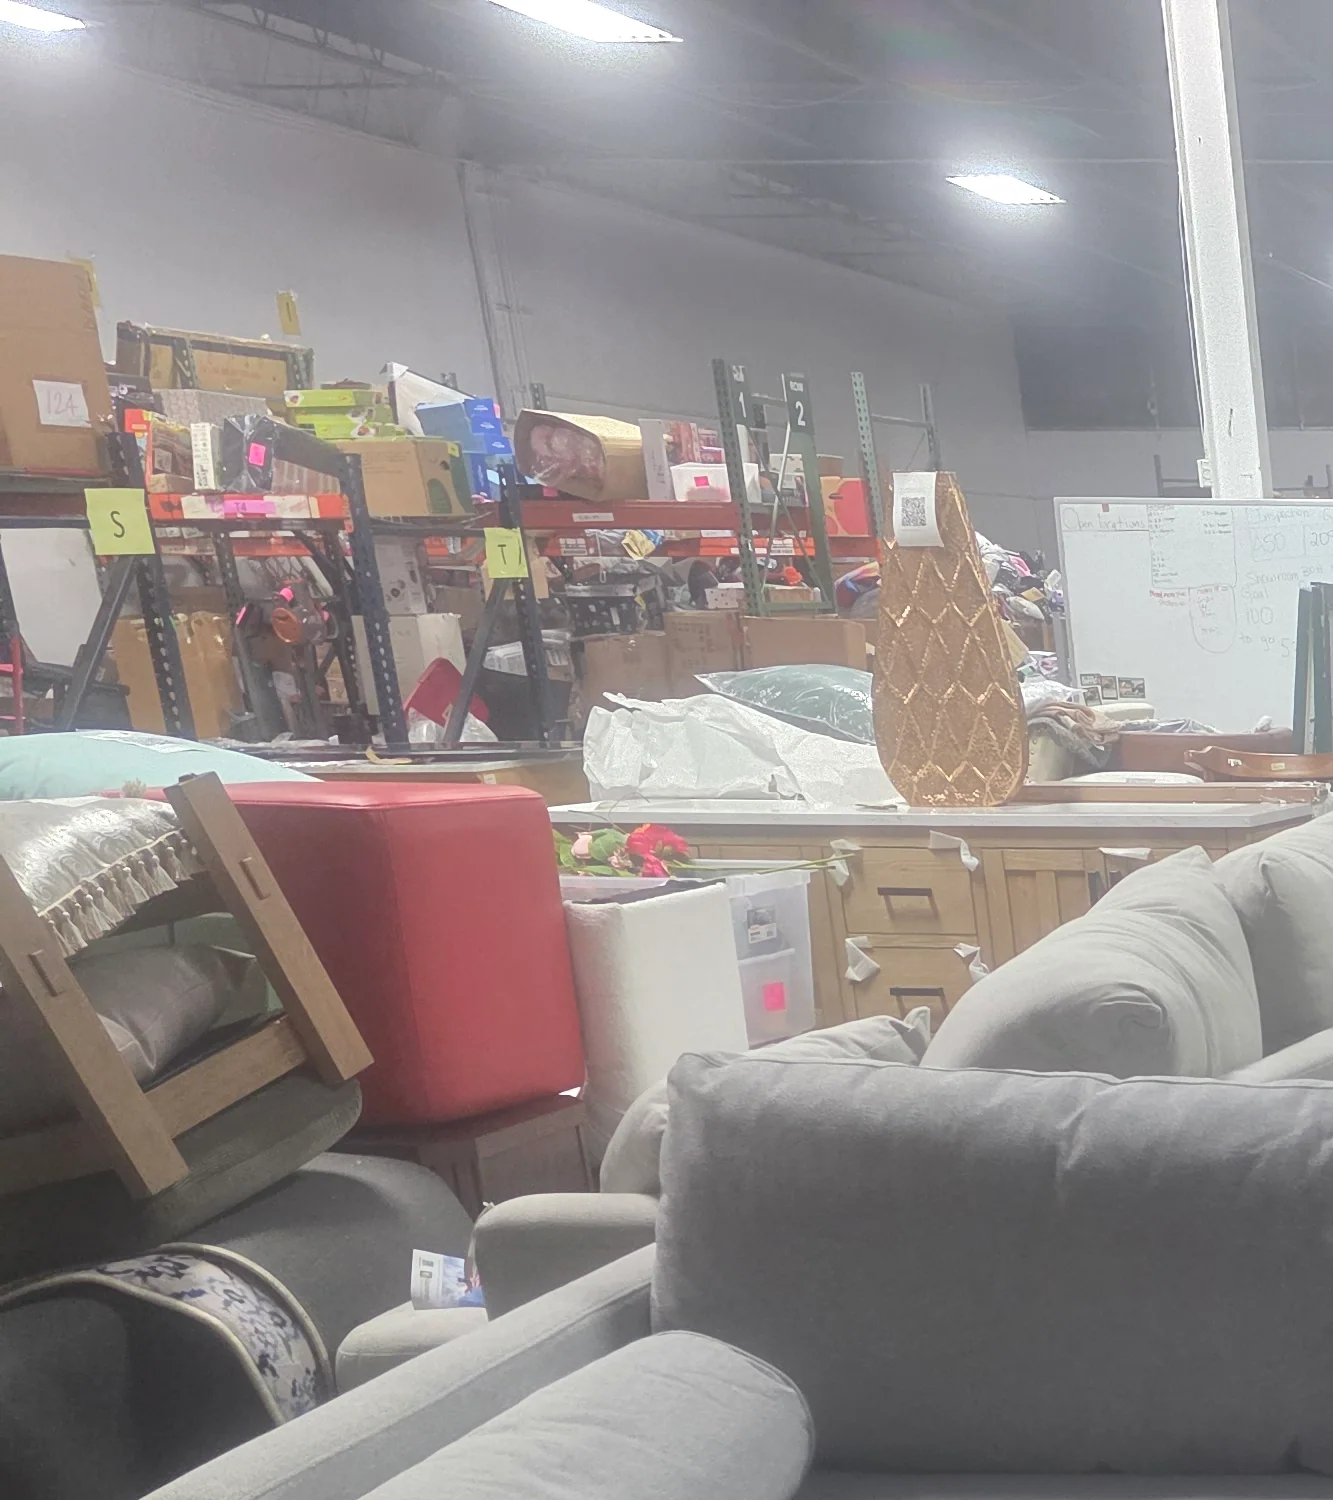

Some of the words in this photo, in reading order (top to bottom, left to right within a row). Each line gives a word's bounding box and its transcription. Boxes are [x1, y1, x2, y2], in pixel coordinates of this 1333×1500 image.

[738, 391, 747, 418] 1
[795, 400, 806, 427] 2
[109, 510, 126, 539] S
